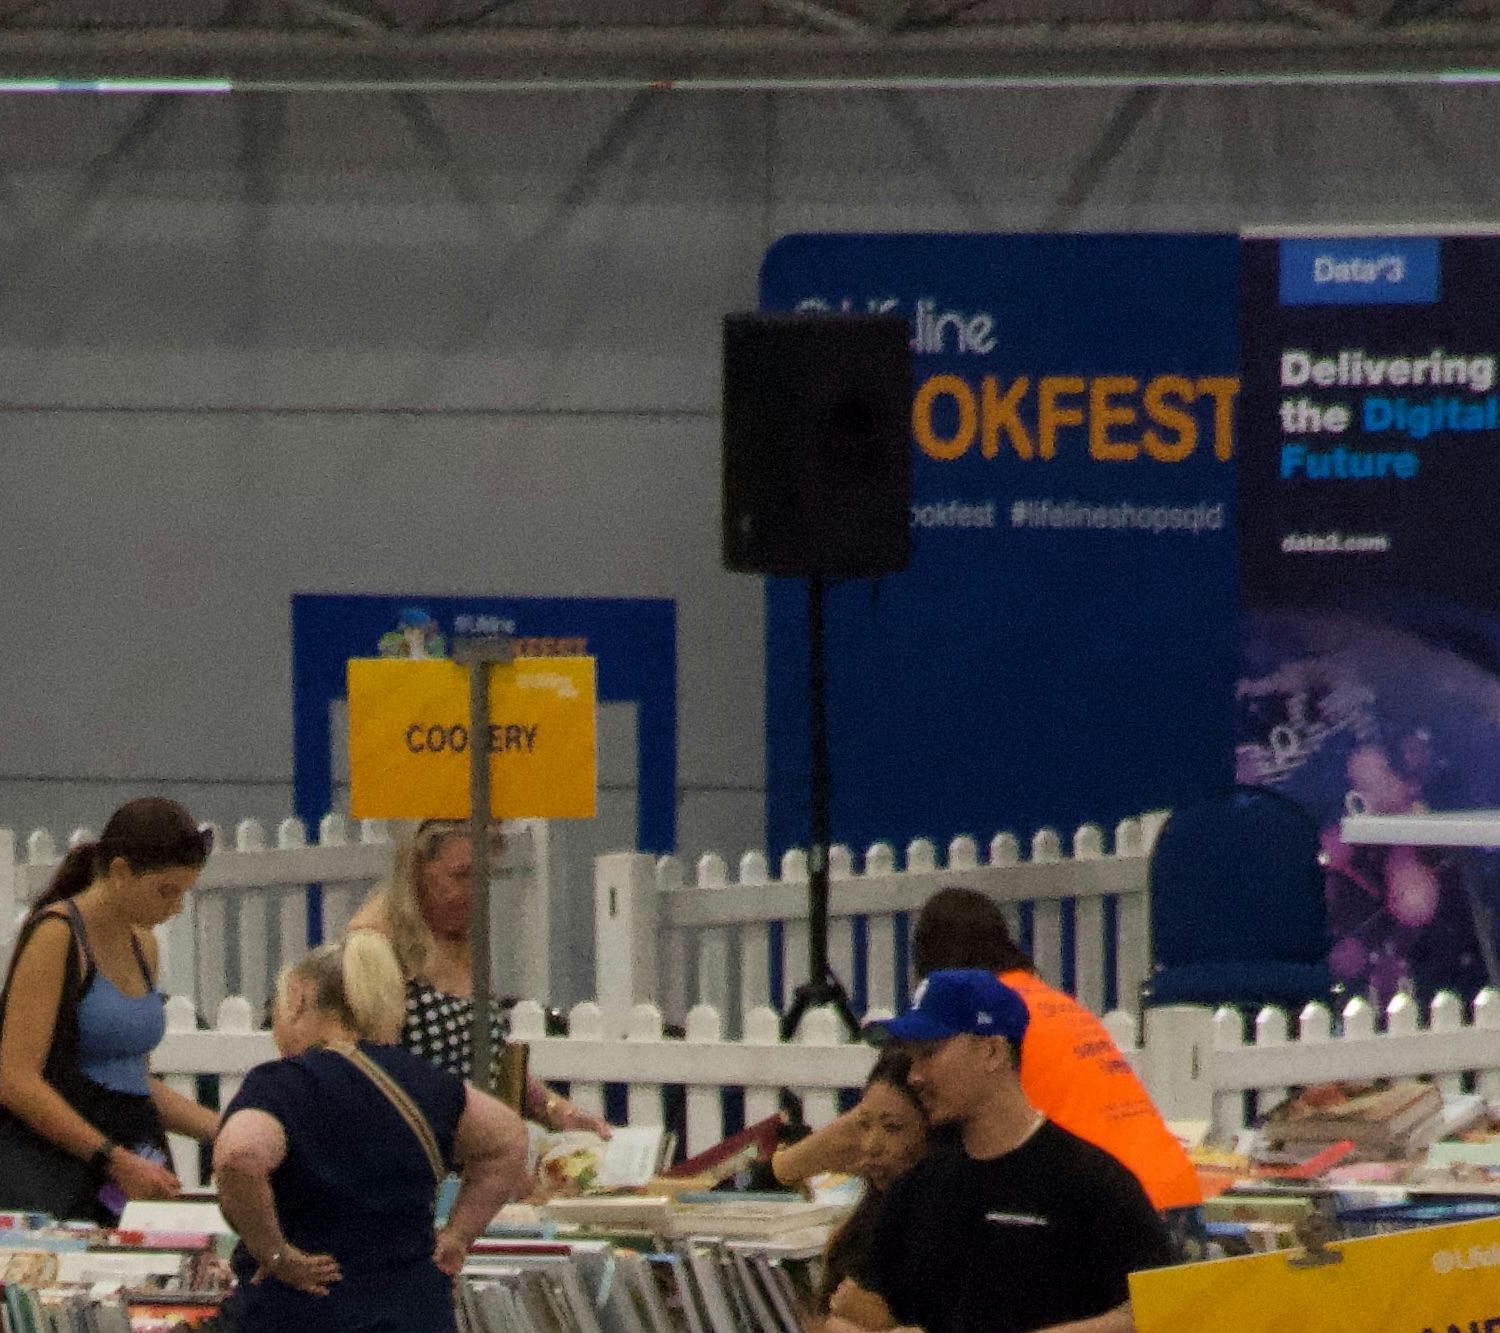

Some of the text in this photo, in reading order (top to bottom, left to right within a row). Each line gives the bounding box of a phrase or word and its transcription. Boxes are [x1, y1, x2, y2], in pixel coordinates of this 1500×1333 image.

[1281, 351, 1496, 391] Delivering
[911, 374, 1241, 461] OKFEST
[1281, 398, 1500, 439] the Digital
[1281, 446, 1420, 480] Future
[405, 722, 539, 753] COOERY
